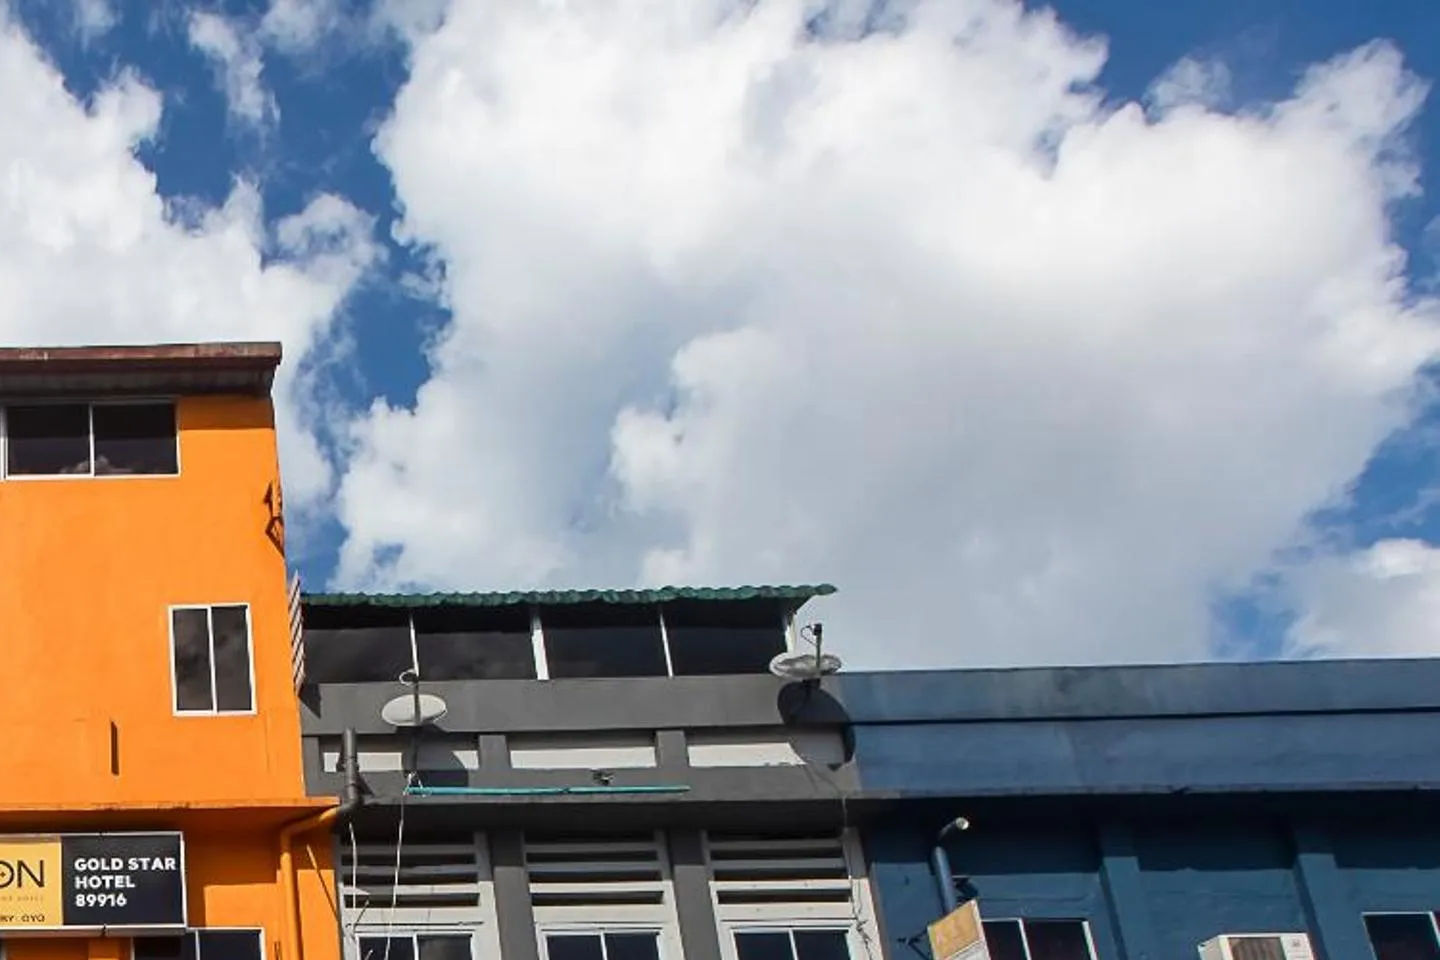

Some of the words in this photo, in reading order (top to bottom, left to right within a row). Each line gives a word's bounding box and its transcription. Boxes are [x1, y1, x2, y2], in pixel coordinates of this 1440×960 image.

[74, 858, 124, 872] GOLD
[127, 857, 177, 871] STAR
[75, 875, 136, 890] HOTEL
[75, 893, 127, 908] 89916
